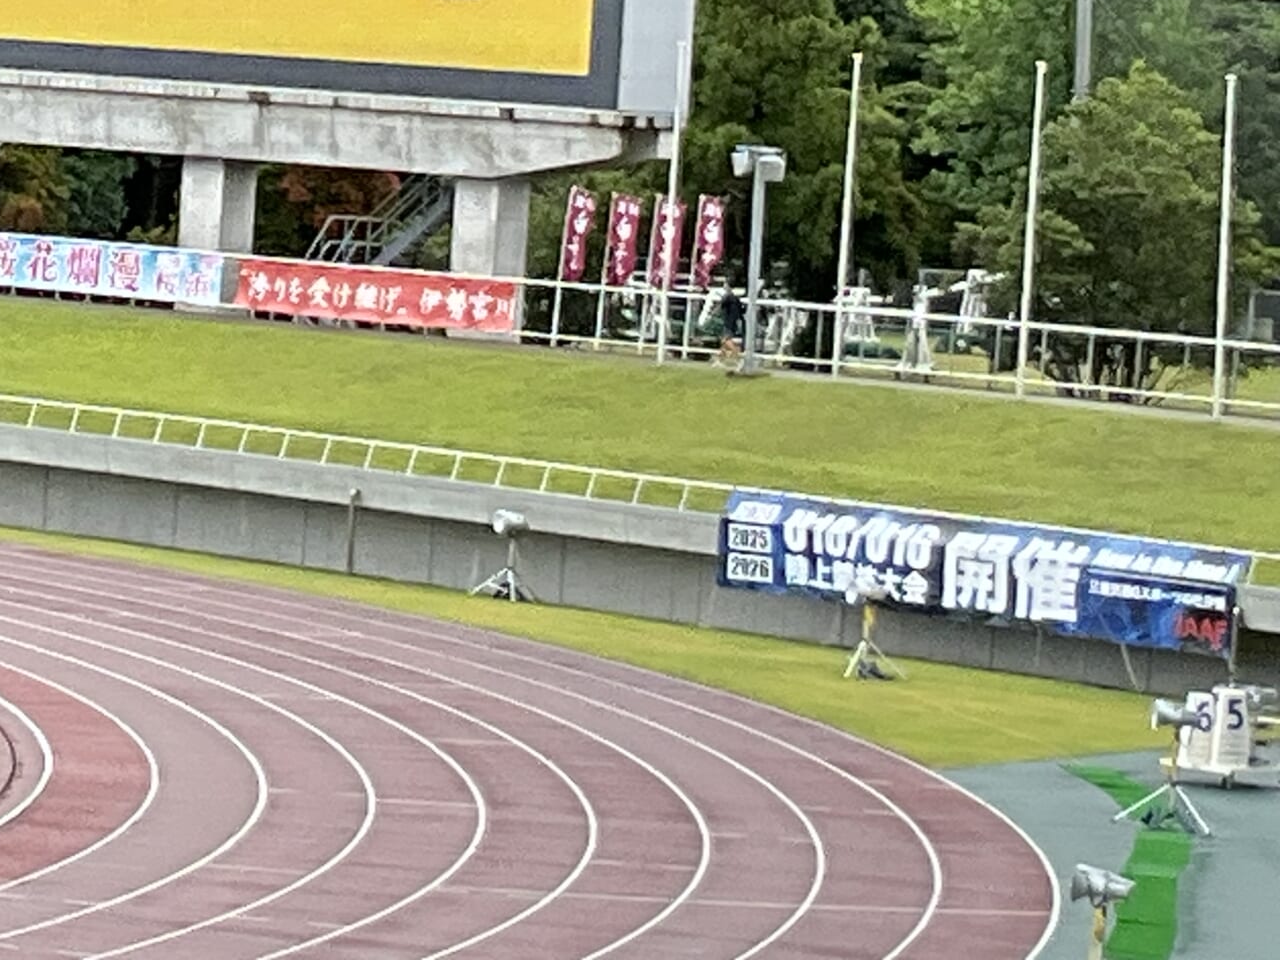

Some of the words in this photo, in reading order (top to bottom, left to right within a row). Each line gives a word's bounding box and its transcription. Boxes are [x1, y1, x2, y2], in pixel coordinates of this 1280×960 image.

[731, 555, 770, 579] 2026
[941, 531, 1091, 623] 開催
[1227, 699, 1244, 730] 5
